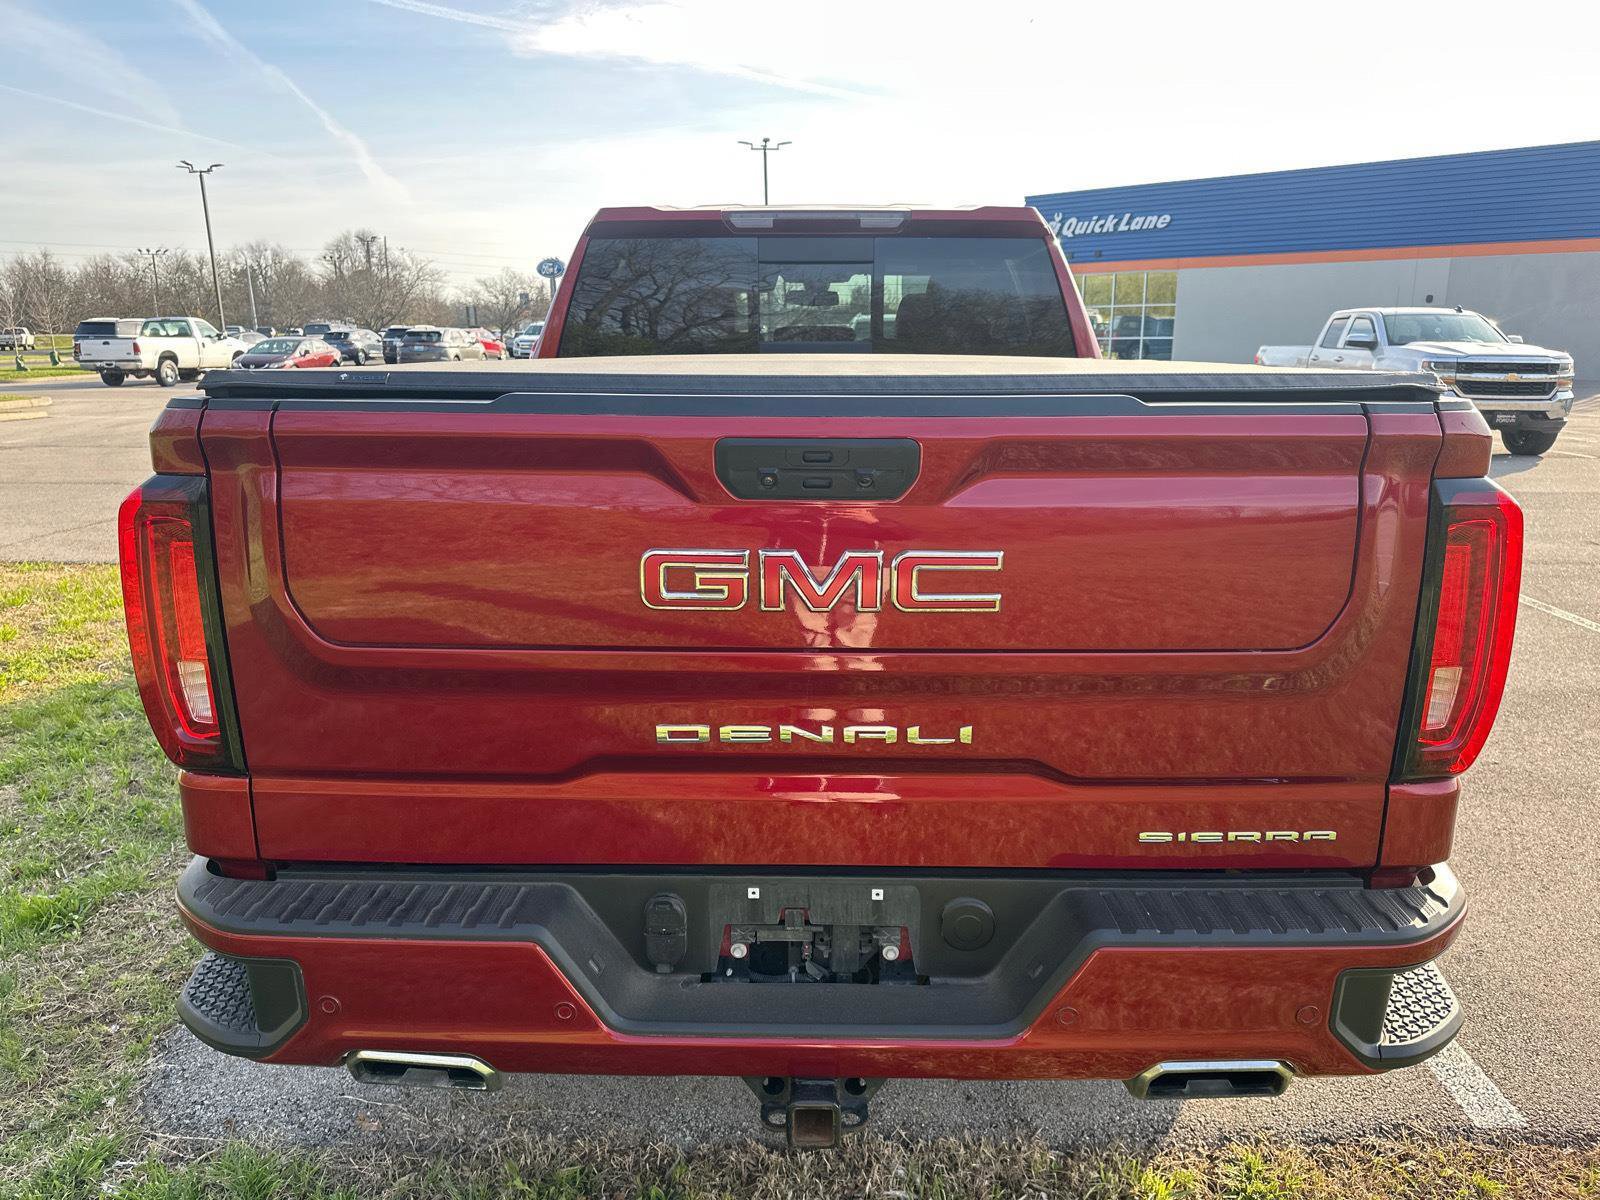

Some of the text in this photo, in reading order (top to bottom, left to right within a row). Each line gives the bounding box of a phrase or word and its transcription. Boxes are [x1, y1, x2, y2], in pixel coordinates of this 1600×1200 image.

[1062, 213, 1171, 237] Quick Lane
[640, 549, 1004, 613] GMC
[655, 724, 974, 744] DENALI
[1138, 831, 1338, 843] SIERRA
